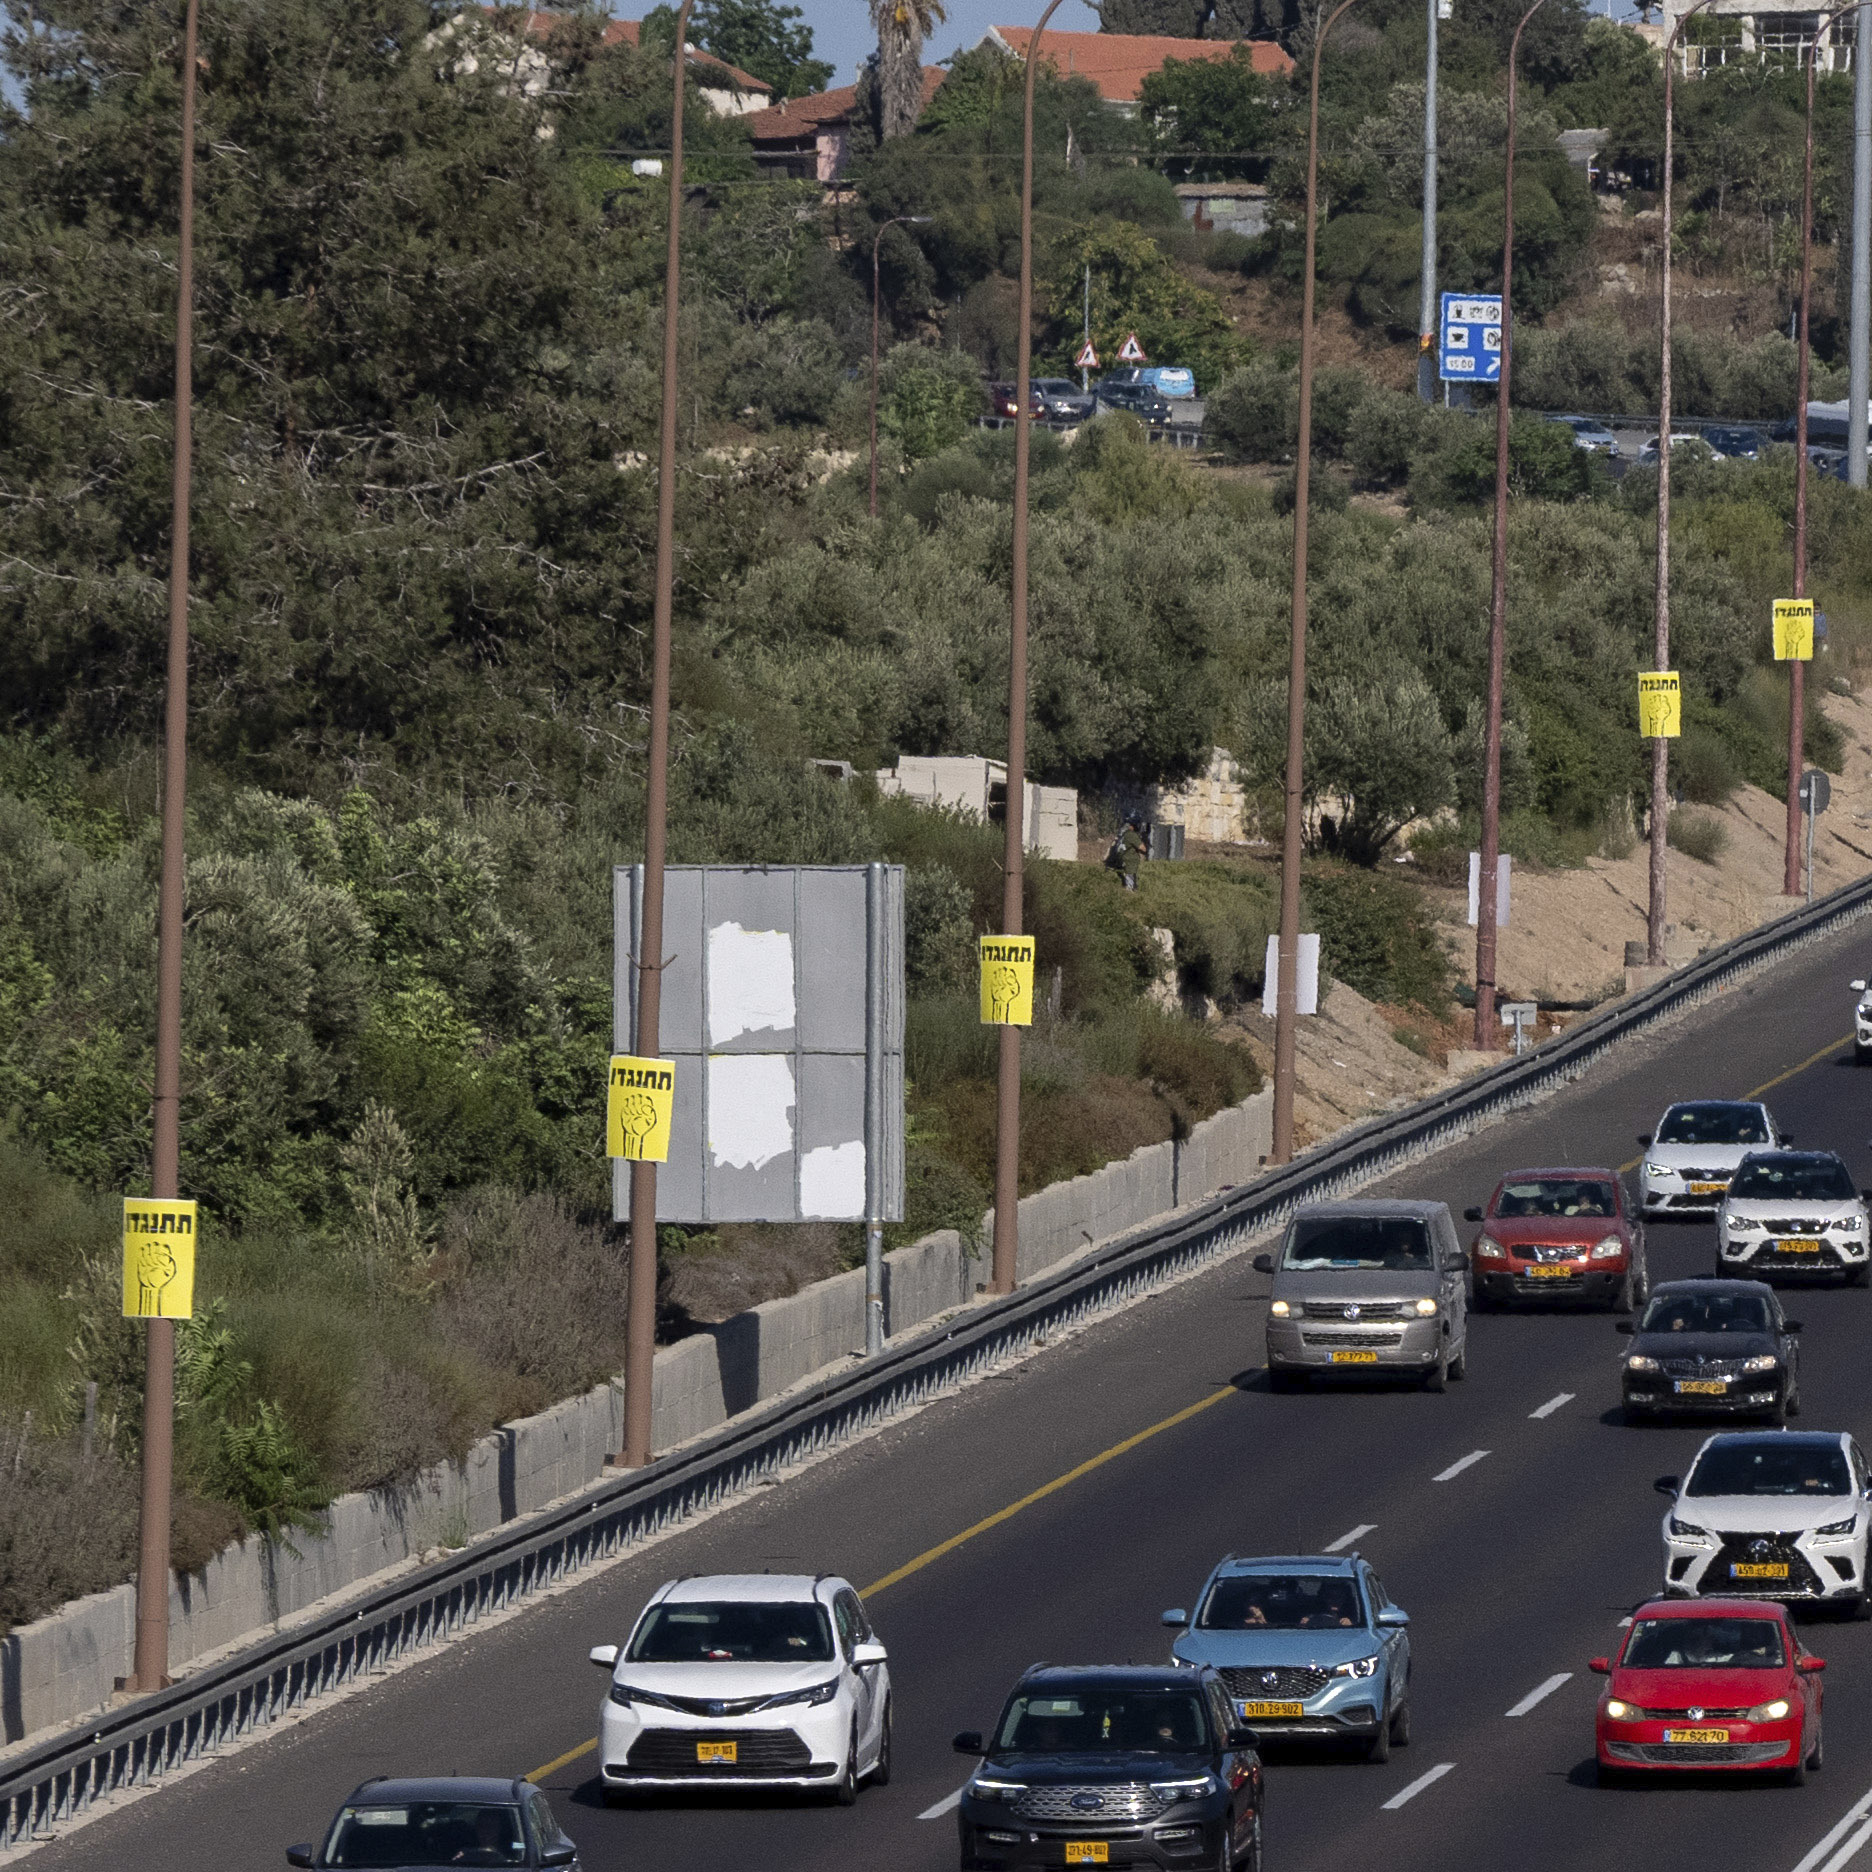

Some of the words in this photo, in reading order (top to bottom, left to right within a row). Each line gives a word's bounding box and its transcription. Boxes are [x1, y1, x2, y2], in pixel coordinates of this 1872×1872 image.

[1775, 606, 1812, 618] תתנגדו
[1639, 678, 1678, 691] תתנגדו
[981, 945, 1031, 962] תתנגדו
[610, 1067, 672, 1090] תתנגדו
[126, 1213, 192, 1233] תתנגדו
